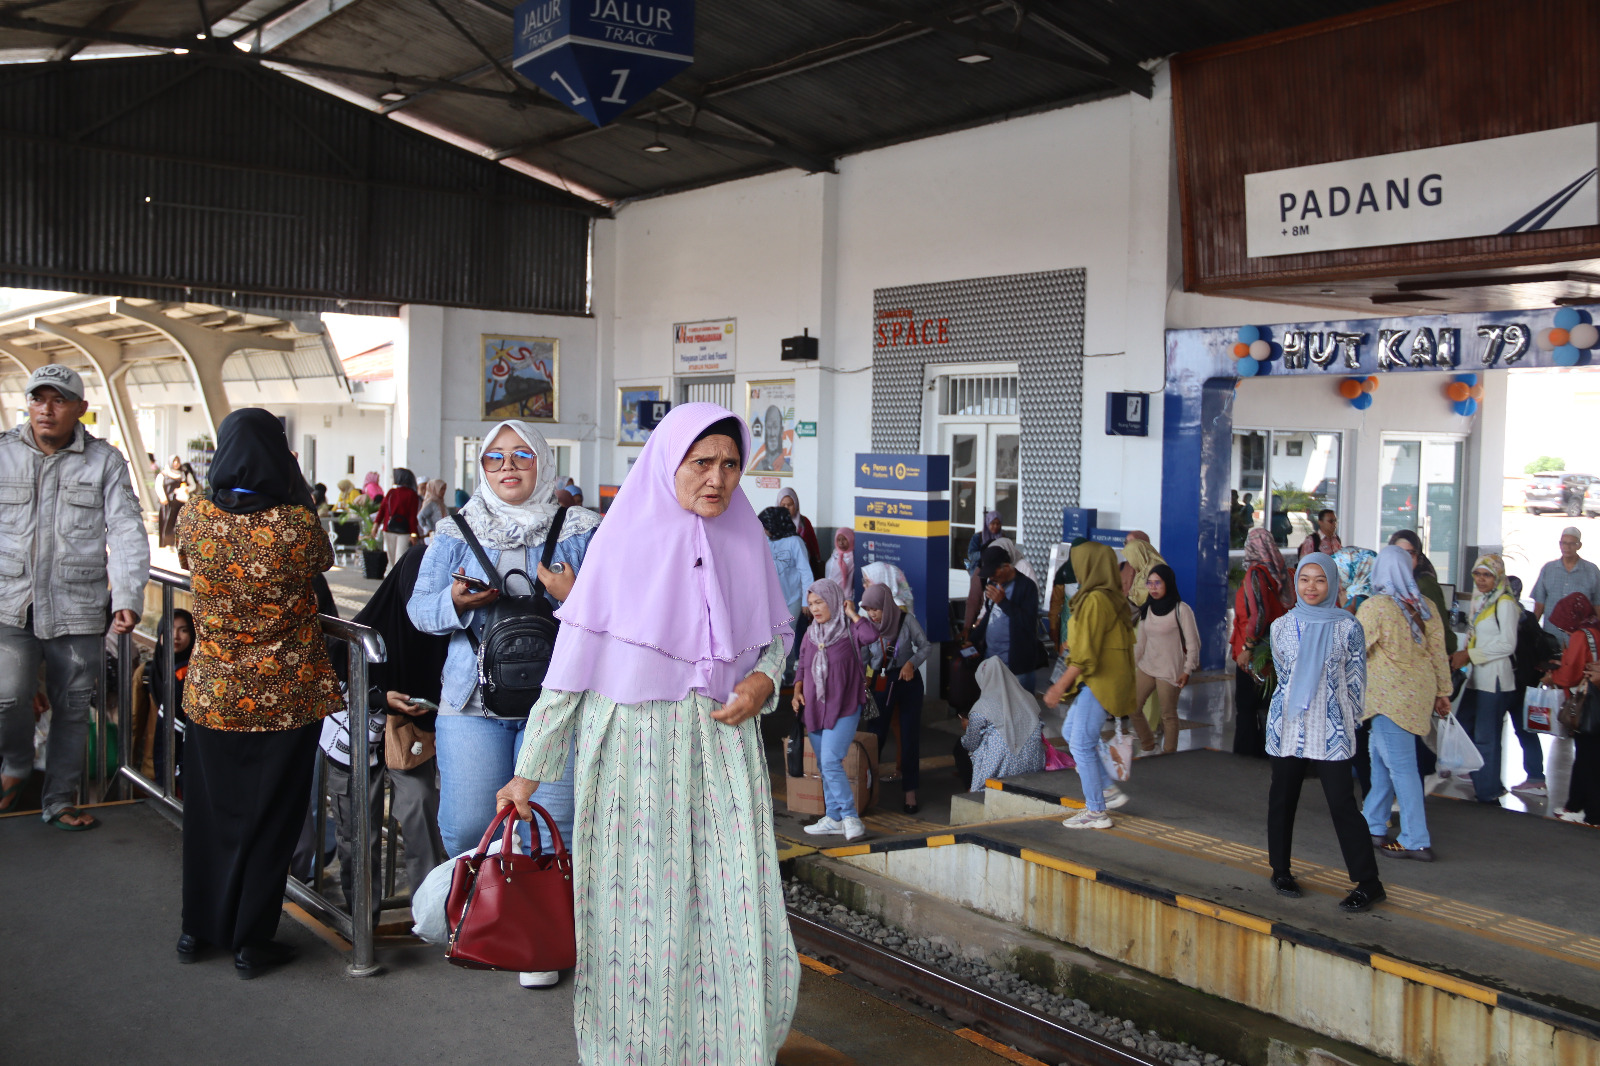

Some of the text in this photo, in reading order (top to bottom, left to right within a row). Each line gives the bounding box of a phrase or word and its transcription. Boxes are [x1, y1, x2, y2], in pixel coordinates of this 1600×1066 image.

[522, 1, 561, 35] JALUR
[590, 0, 672, 30] JALUR
[528, 29, 552, 49] TRACK
[605, 26, 657, 47] TRACK
[550, 71, 586, 106] 1
[601, 69, 630, 105] 1
[1280, 174, 1443, 222] PADANG
[1292, 225, 1310, 236] 8M
[877, 318, 949, 348] SPACE
[1284, 323, 1530, 372] HUT KAI 79
